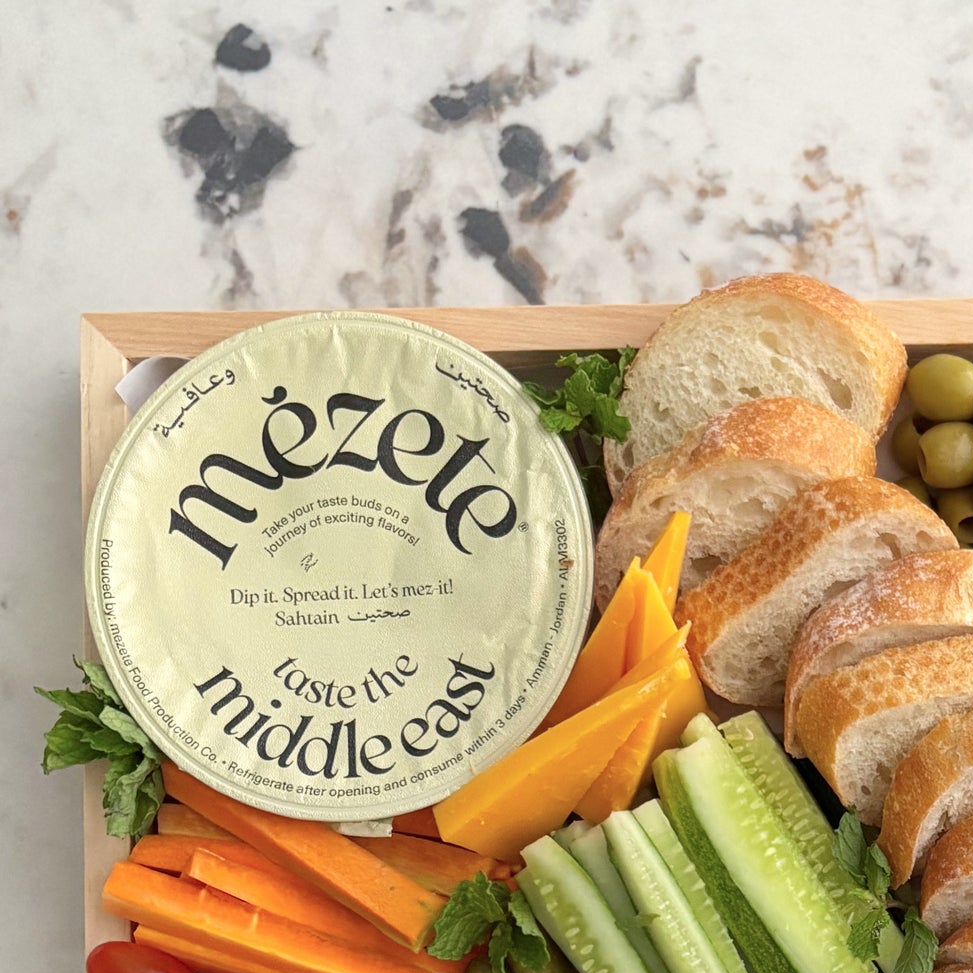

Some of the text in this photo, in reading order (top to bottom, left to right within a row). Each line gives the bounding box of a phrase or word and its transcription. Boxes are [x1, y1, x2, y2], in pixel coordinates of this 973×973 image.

[435, 362, 510, 423] صحتين
[262, 495, 410, 539] Take your taste buds on a
[264, 512, 420, 558] journey of exciting flavors!
[100, 538, 114, 600] Produced
[230, 588, 260, 607] Dip
[263, 589, 278, 604] it.
[283, 586, 339, 606] Spread
[344, 585, 359, 599] it.
[402, 579, 454, 597] mez-it!
[105, 603, 117, 621] by:
[275, 610, 340, 627] Sahtain
[348, 607, 411, 623] صحتين
[550, 592, 567, 634] Jordan
[526, 642, 553, 689] Amman
[128, 666, 152, 697] Food
[273, 655, 419, 709] taste the
[149, 696, 200, 750] Production
[193, 652, 495, 780] middle east
[495, 718, 505, 729] 3
[504, 695, 526, 721] days
[200, 747, 218, 764] Co.
[464, 727, 497, 756] within
[228, 760, 294, 793] Refrigerate
[410, 752, 464, 784] consume
[296, 784, 327, 797] after
[329, 784, 381, 799] opening
[384, 777, 407, 792] and
